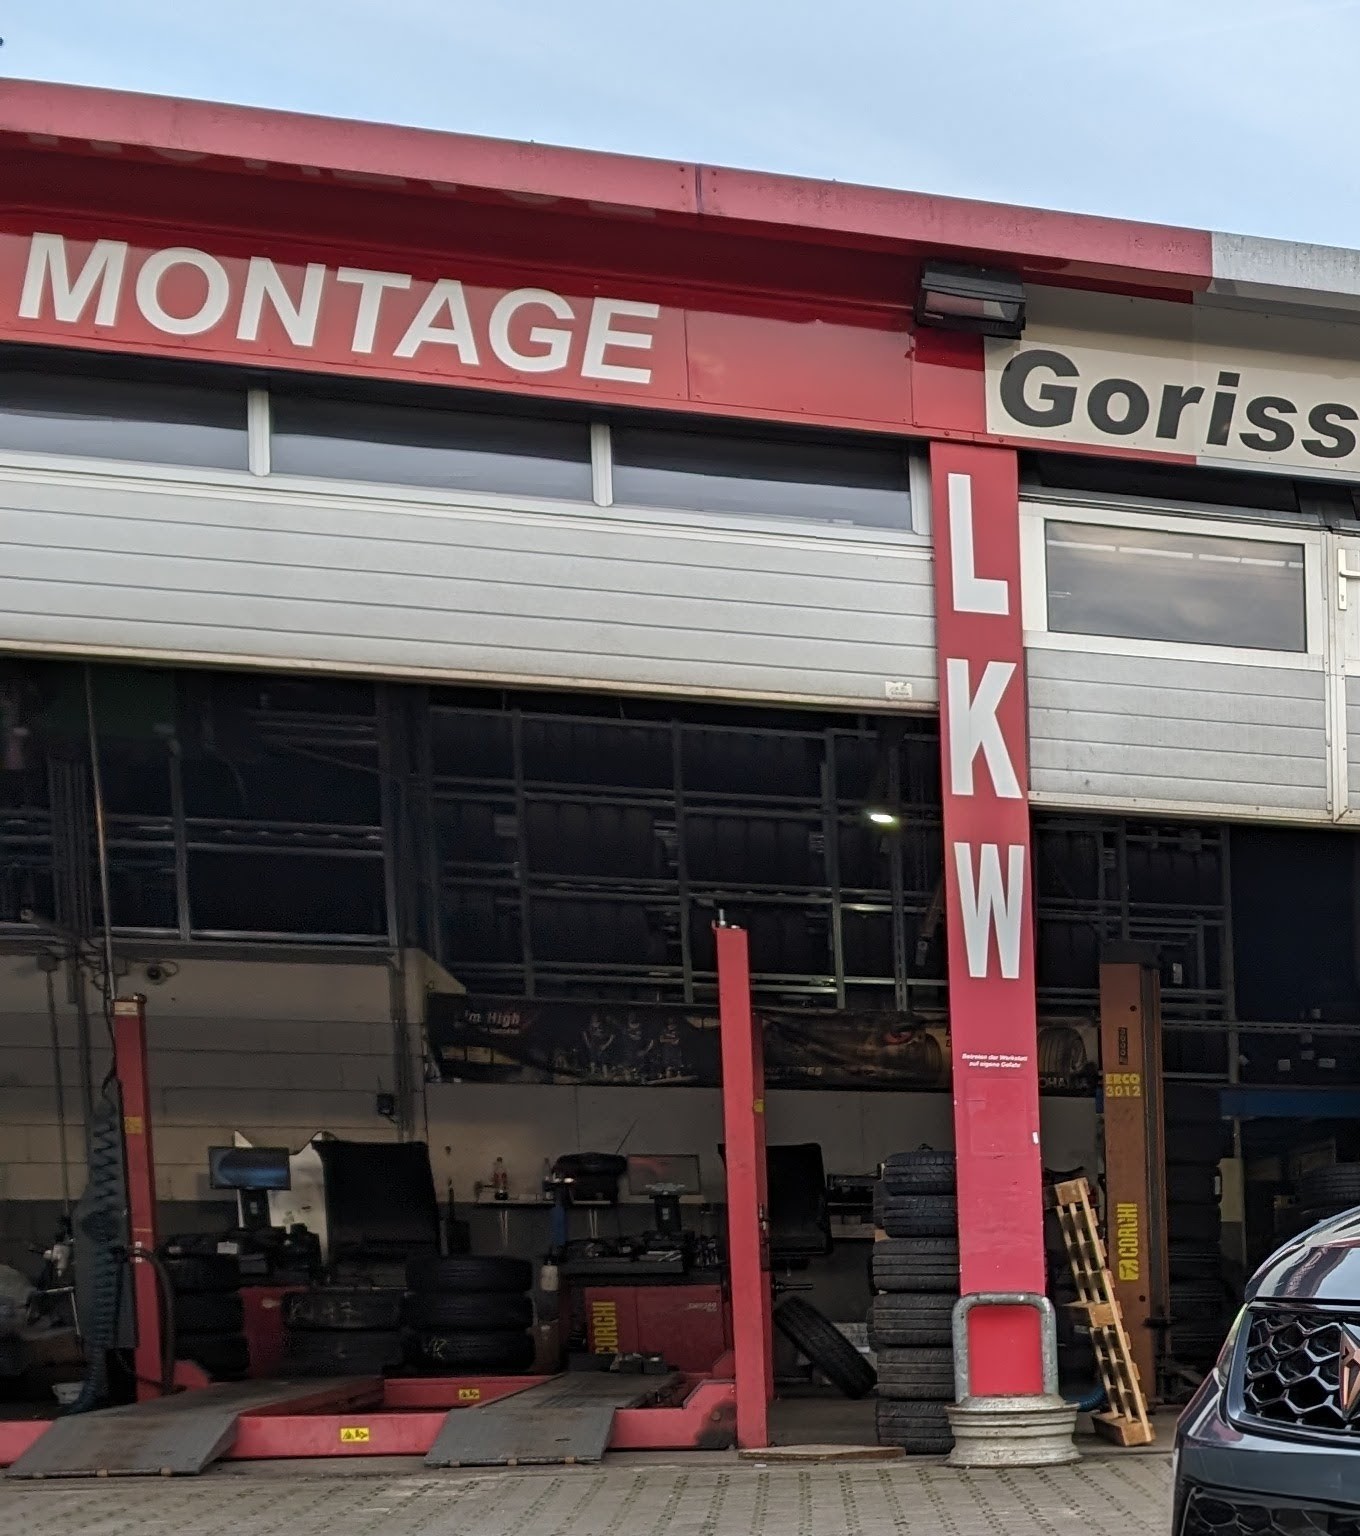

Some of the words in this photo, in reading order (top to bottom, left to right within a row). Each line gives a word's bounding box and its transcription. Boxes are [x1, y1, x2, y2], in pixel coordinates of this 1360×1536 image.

[18, 231, 661, 385] MONTAGE
[946, 472, 1026, 980] LKW
[1105, 1073, 1141, 1085] ERCO
[1105, 1085, 1141, 1097] 3012
[1117, 1203, 1138, 1258] CORGHI
[592, 1301, 619, 1355] CORGHI
